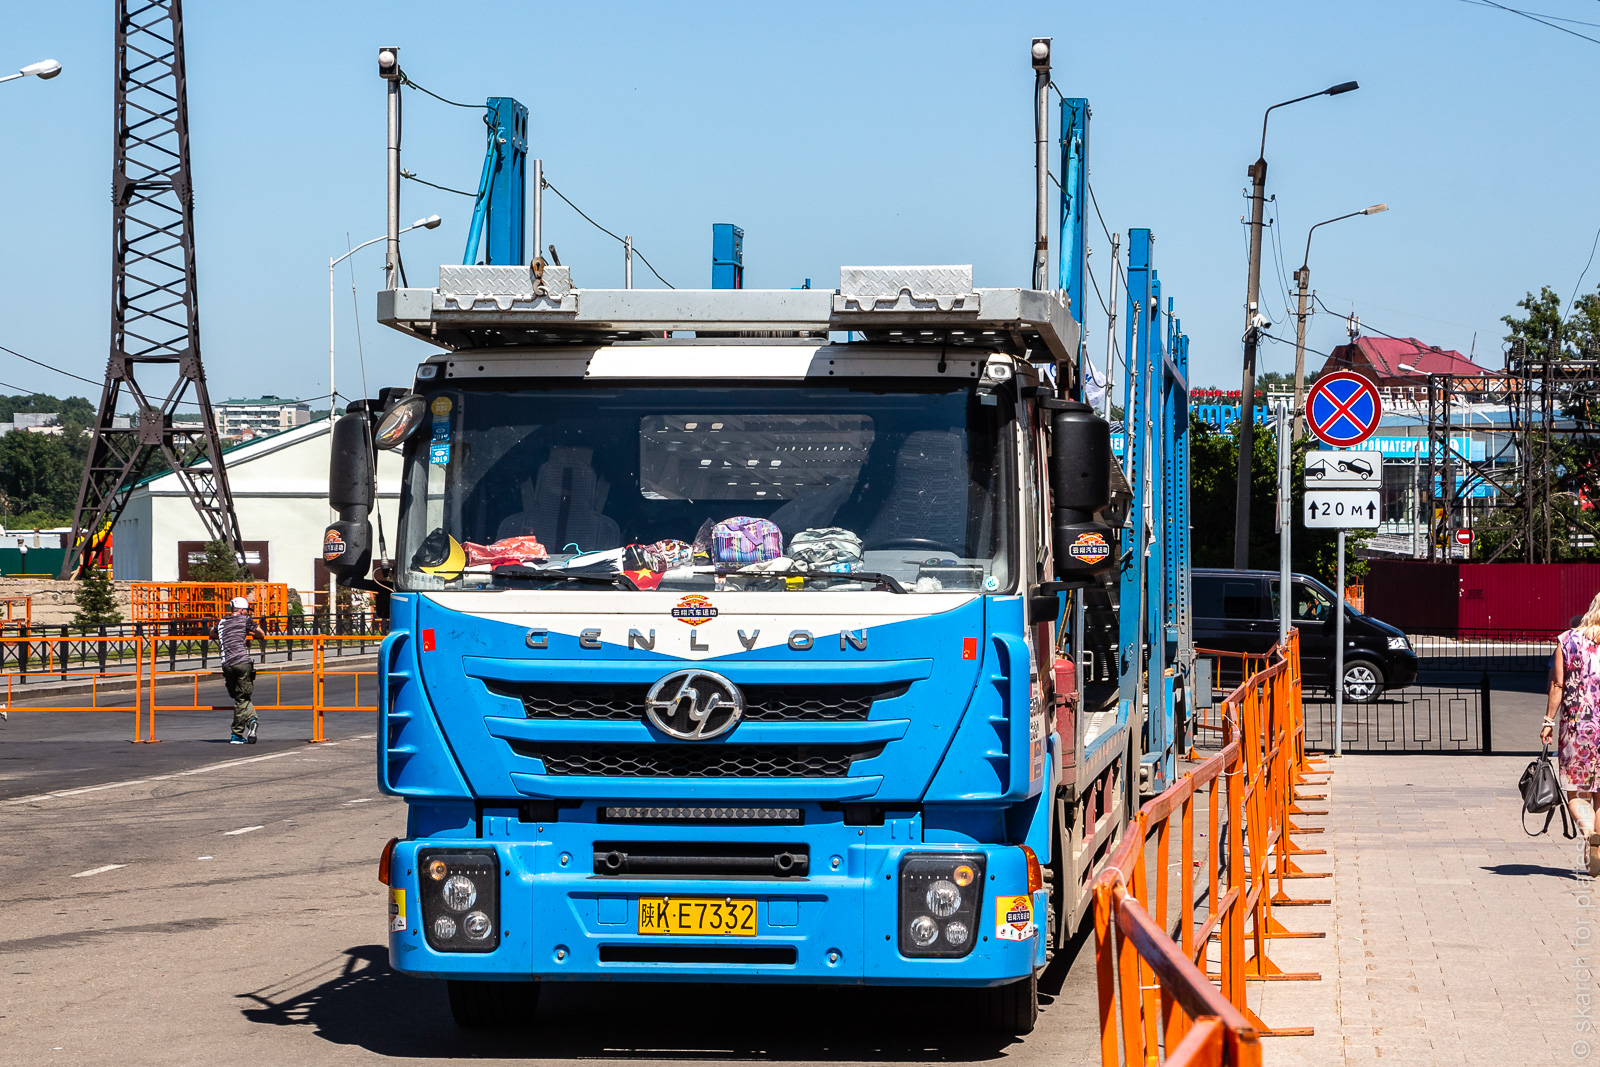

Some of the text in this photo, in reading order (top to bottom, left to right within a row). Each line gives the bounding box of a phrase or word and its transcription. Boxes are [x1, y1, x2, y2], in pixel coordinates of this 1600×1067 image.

[1190, 389, 1263, 398] ОВЫЙ ЦЕР
[1321, 502, 1345, 516] 20
[673, 608, 717, 616] 云翔汽车运动
[525, 627, 868, 652] GENLYON
